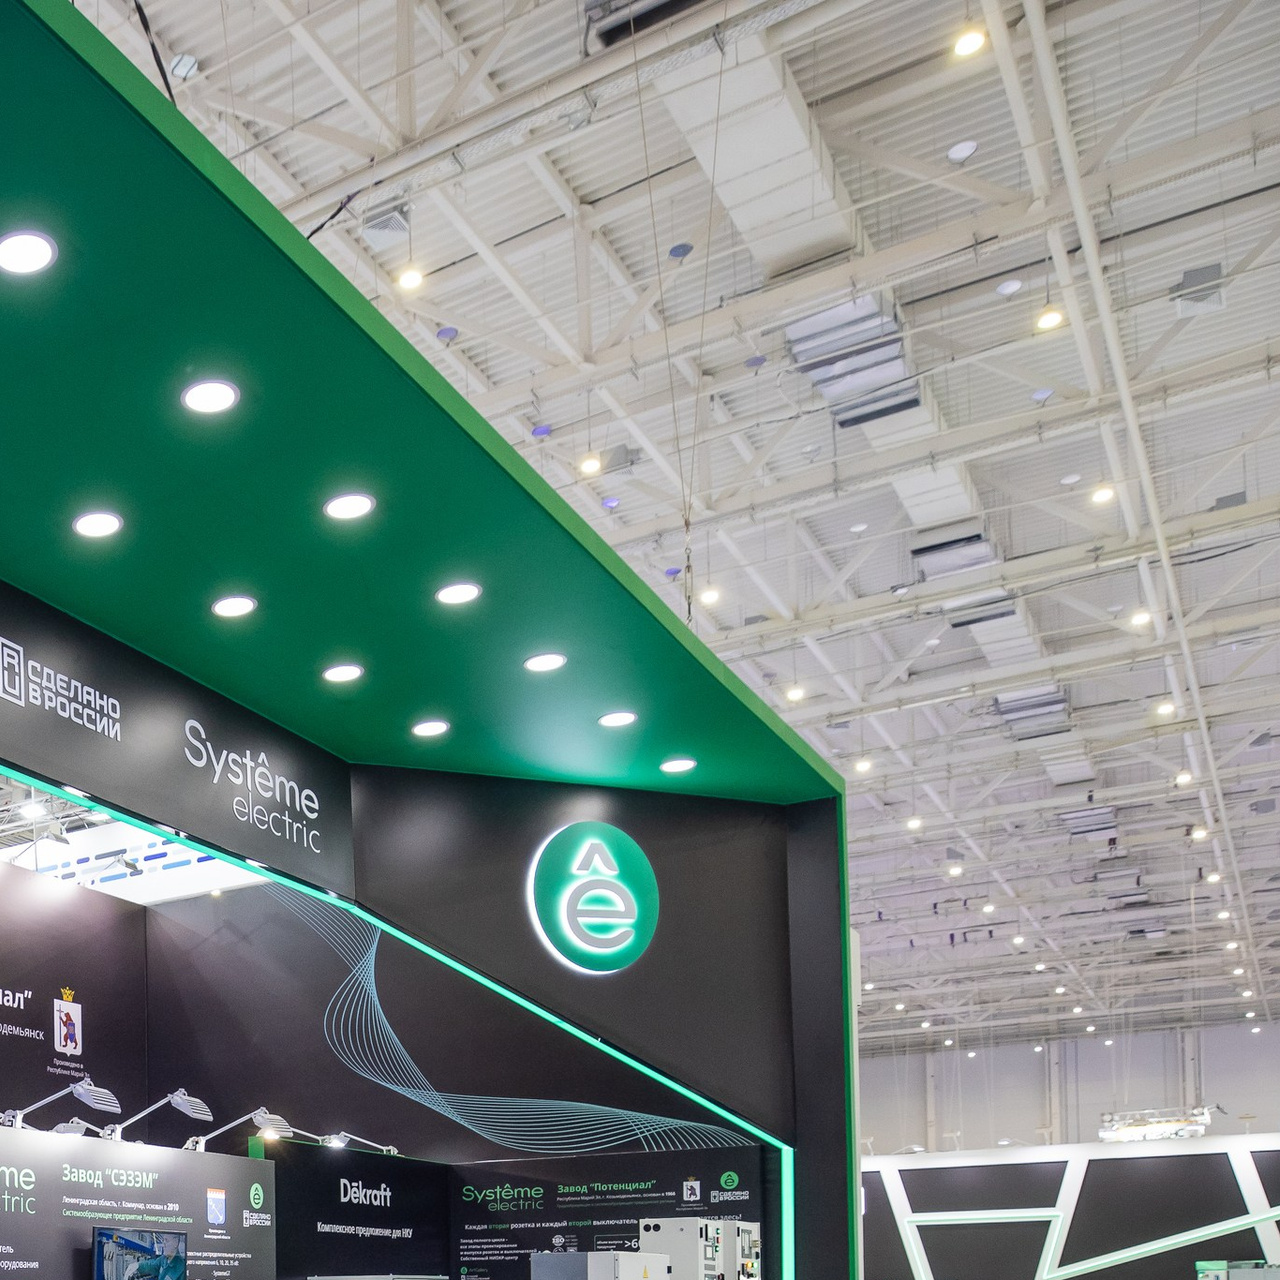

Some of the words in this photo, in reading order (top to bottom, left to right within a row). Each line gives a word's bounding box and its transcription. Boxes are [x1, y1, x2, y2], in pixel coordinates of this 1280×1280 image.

[27, 659, 121, 719] СДЕЛАНО
[184, 718, 320, 820] Systême
[232, 791, 322, 854] electric
[61, 1163, 104, 1189] Завод
[105, 1167, 159, 1189] “СЭЗЭМ”
[462, 1183, 544, 1204] Systême
[557, 1184, 588, 1194] Завод
[589, 1180, 657, 1192] “Потенциал”
[167, 1202, 180, 1211] 2010
[488, 1199, 544, 1211] electric
[317, 1221, 355, 1235] Комплексное
[355, 1226, 392, 1237] предложение
[391, 1229, 401, 1239] для
[401, 1228, 413, 1239] НКУ
[510, 1222, 535, 1230] розетка
[568, 1219, 592, 1227] второй
[592, 1218, 638, 1226] выключатель
